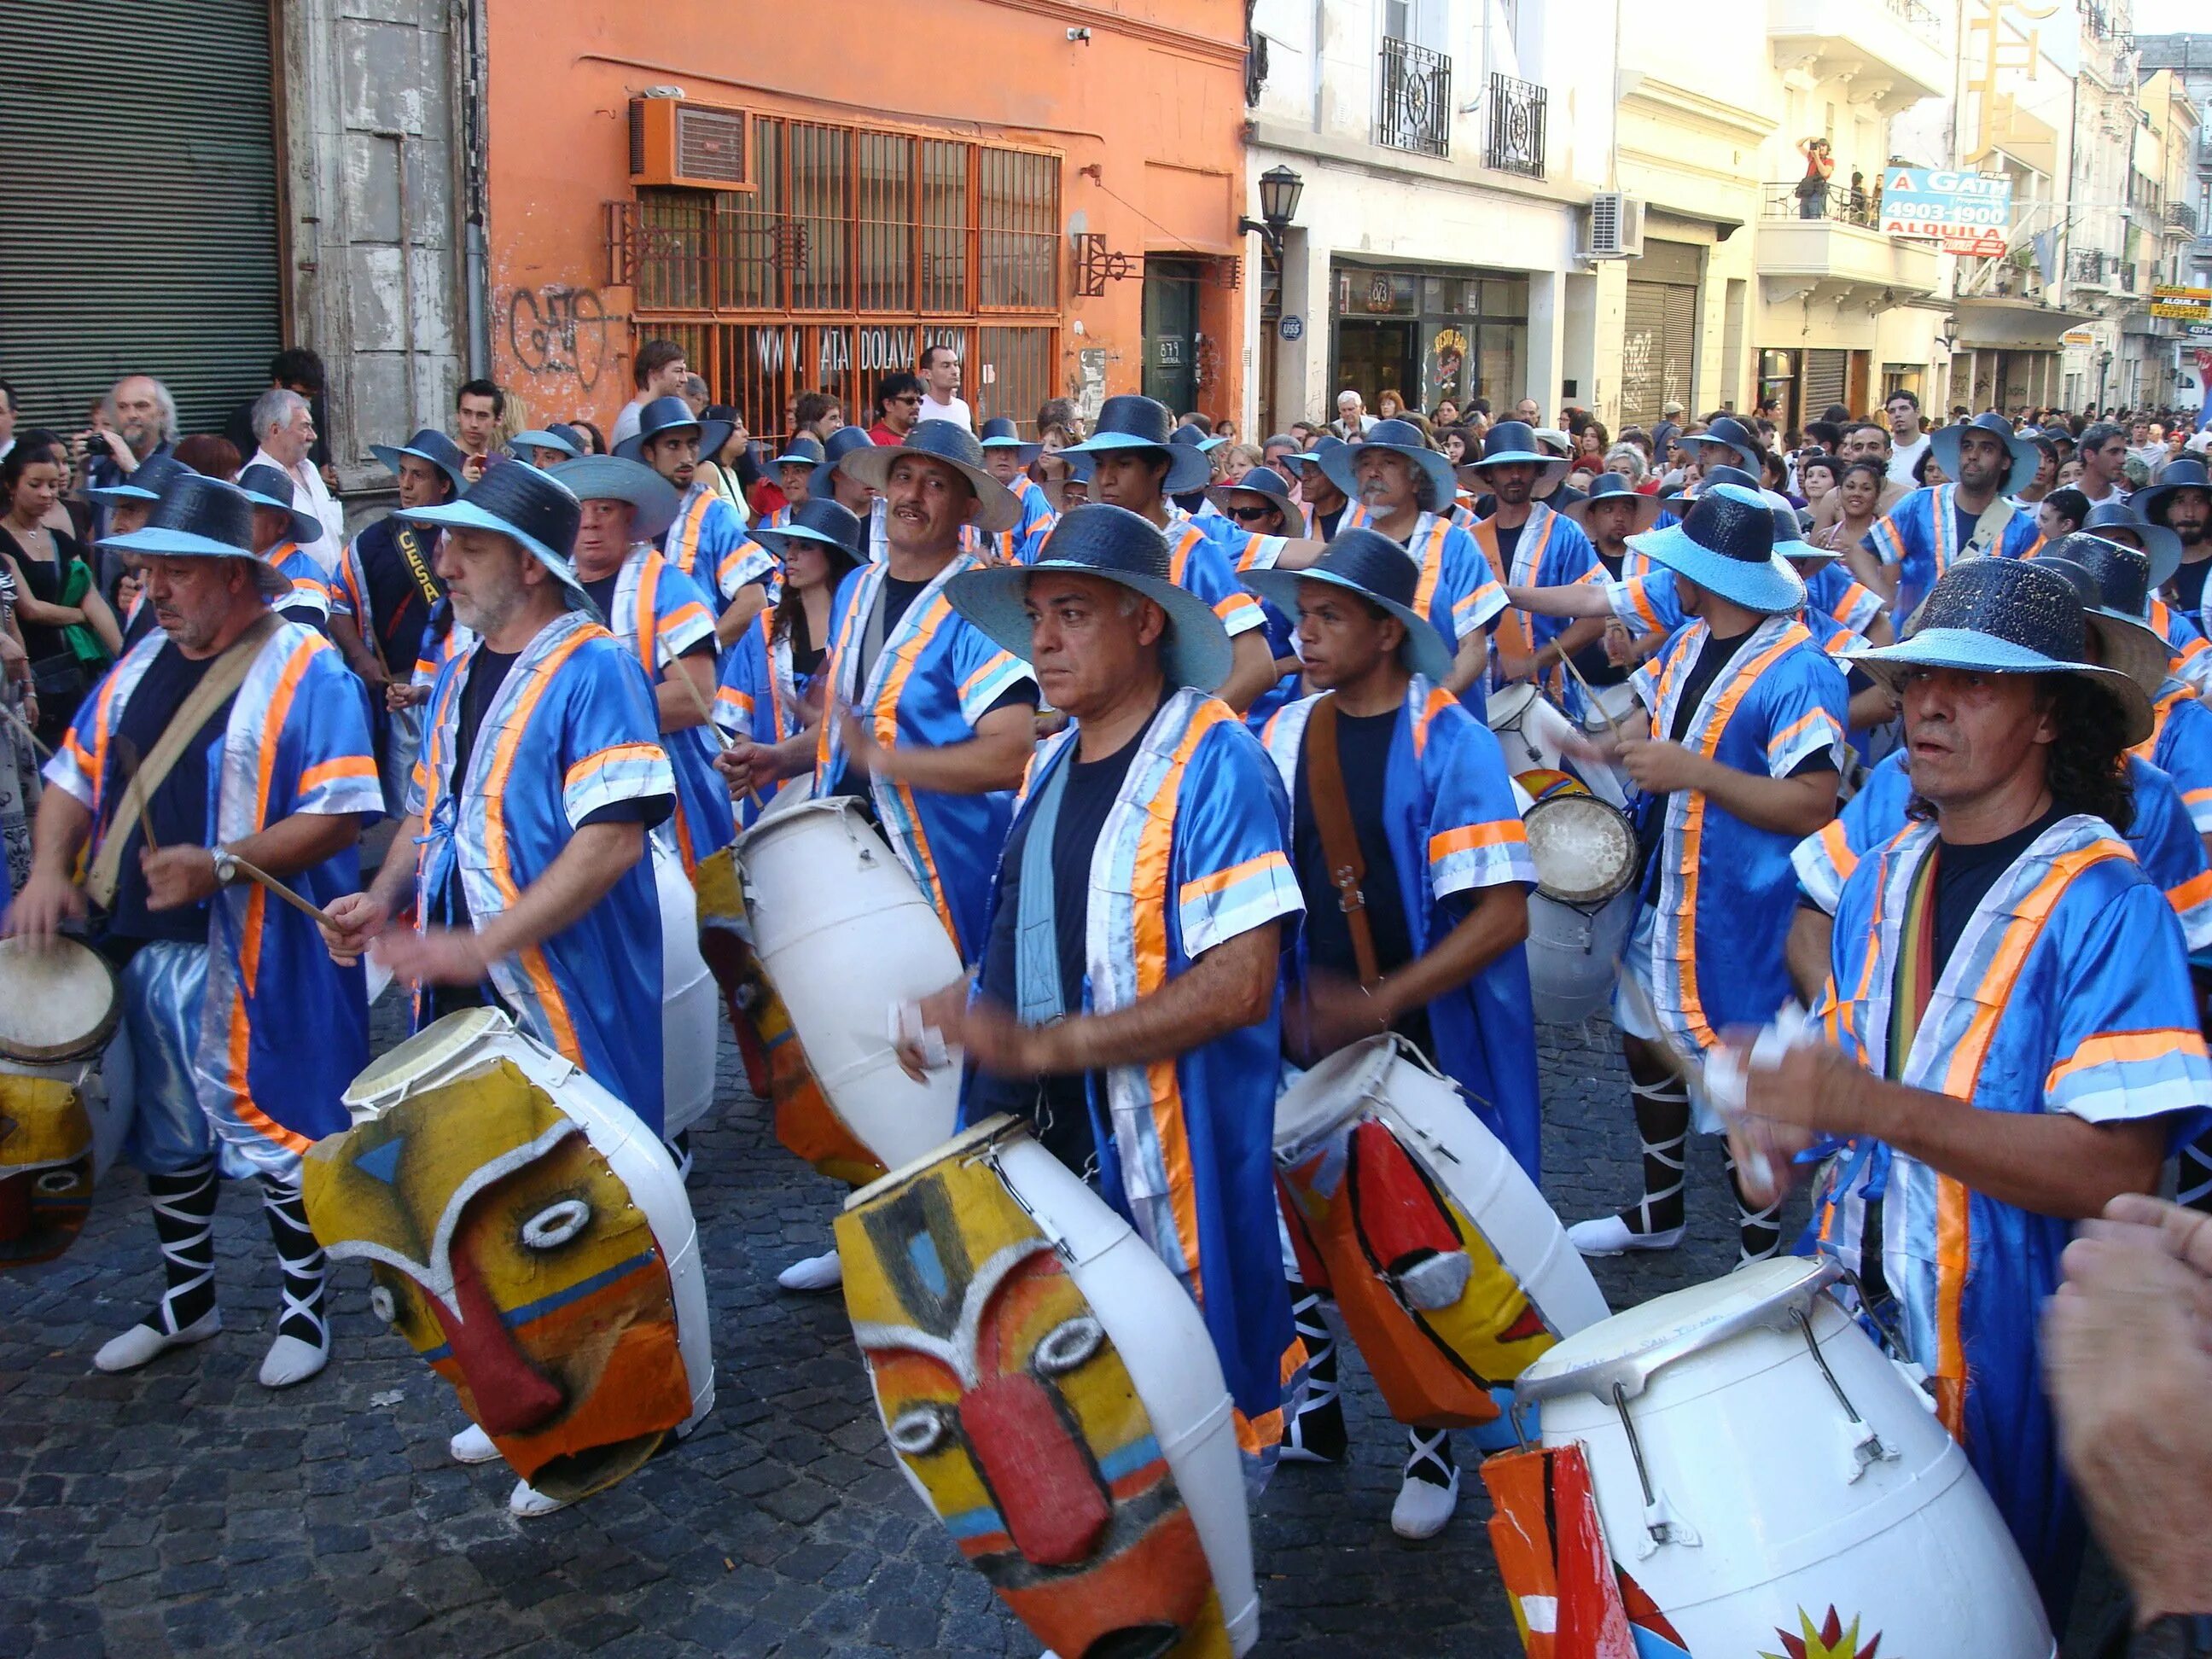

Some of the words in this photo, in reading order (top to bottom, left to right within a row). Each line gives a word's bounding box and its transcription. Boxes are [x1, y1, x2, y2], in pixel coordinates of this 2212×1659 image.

[1895, 177, 1909, 189] A
[1884, 201, 2005, 224] 4903-1900
[1886, 221, 2000, 239] ALQUILA
[1372, 282, 1387, 301] 873
[2162, 297, 2200, 306] ALQUILA
[1283, 323, 1301, 335] USS
[1161, 341, 1179, 357] 879
[398, 530, 440, 607] CESA
